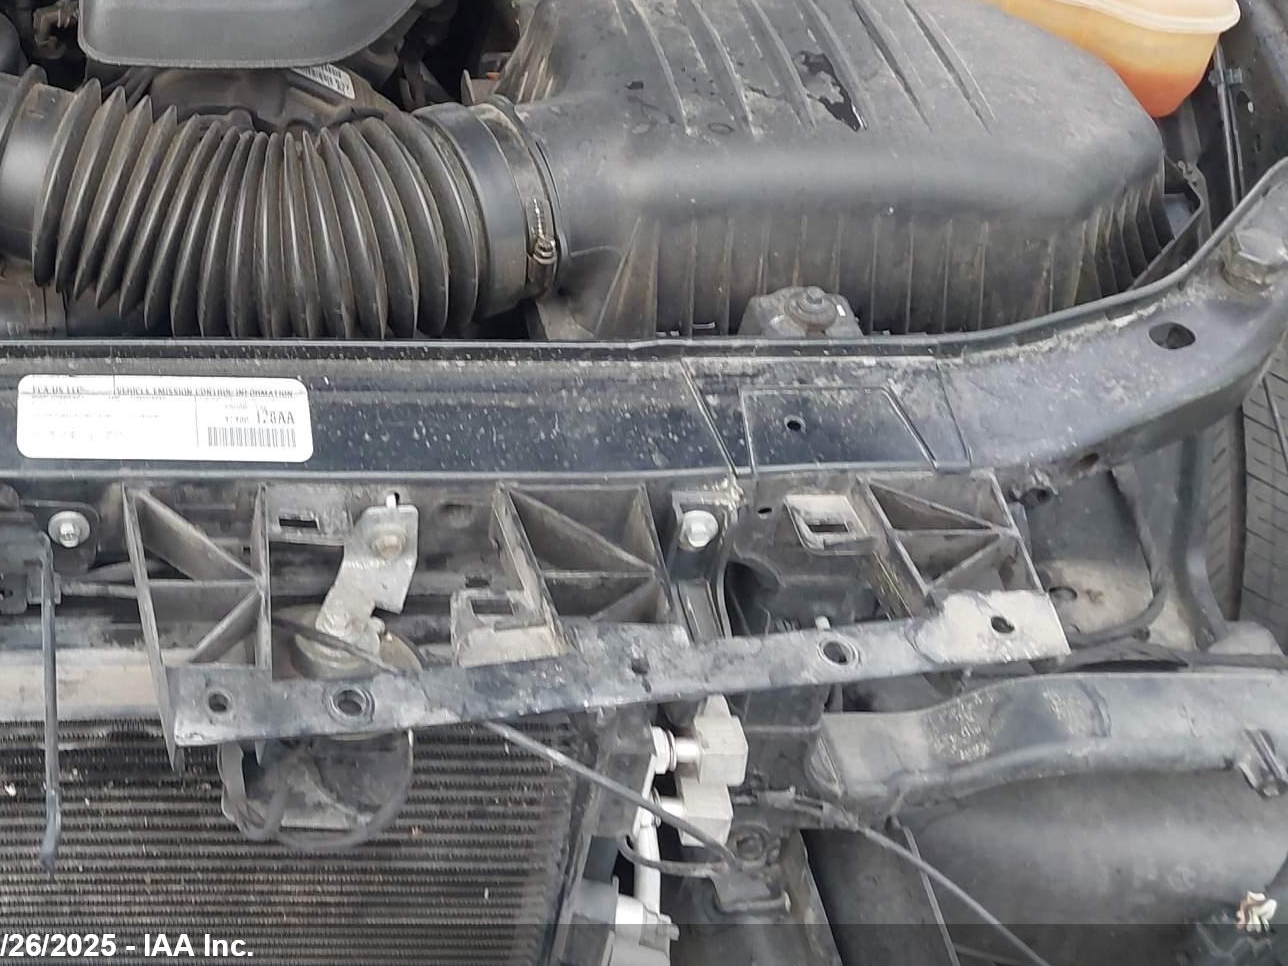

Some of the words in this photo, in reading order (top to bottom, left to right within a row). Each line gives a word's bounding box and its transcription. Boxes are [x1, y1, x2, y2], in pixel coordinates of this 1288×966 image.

[153, 387, 193, 397] EMISSION
[195, 388, 232, 398] CONTROL
[235, 389, 294, 399] INFORMATION
